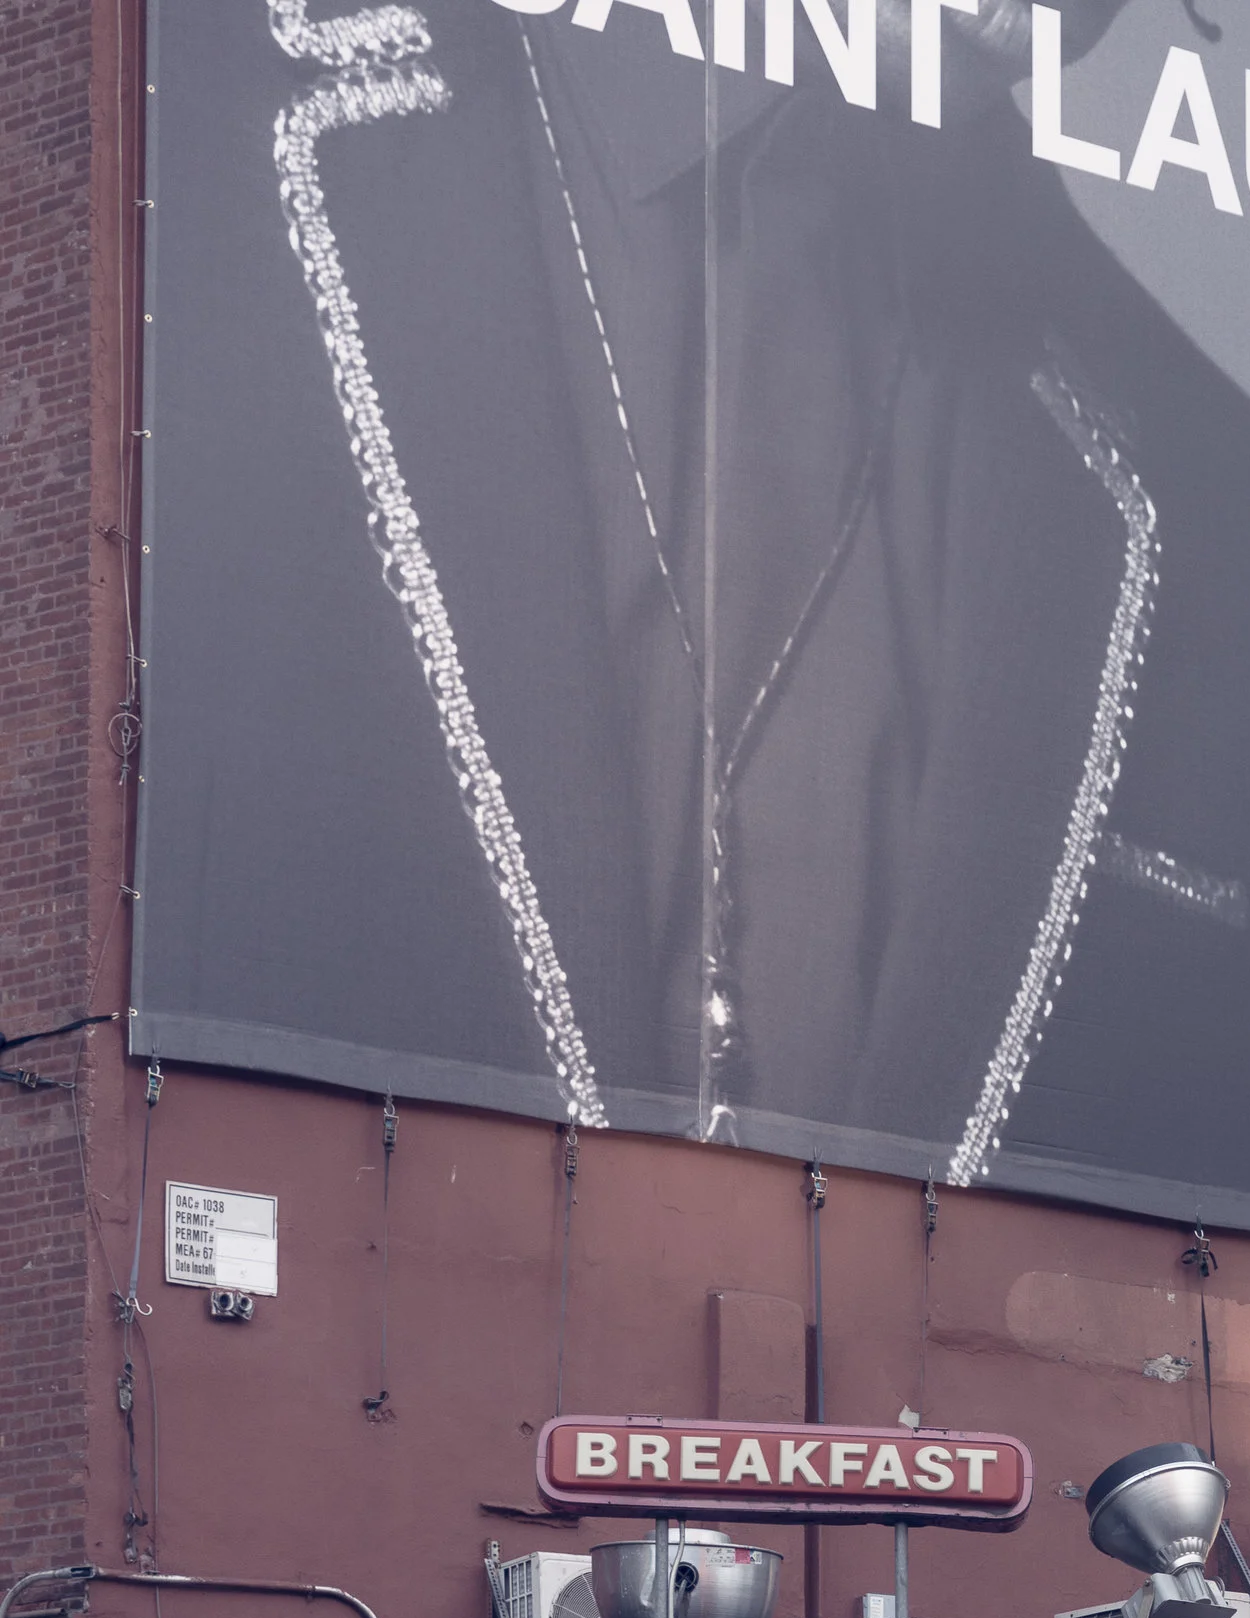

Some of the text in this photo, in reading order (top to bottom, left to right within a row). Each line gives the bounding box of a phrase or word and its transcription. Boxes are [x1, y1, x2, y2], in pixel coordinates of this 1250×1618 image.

[202, 1199, 225, 1213] 1038
[175, 1211, 214, 1227] PERMIT#
[175, 1227, 214, 1243] PERMIT#
[175, 1243, 200, 1258] MEA#
[175, 1259, 190, 1272] Date
[575, 1431, 998, 1495] BREAKFAST
